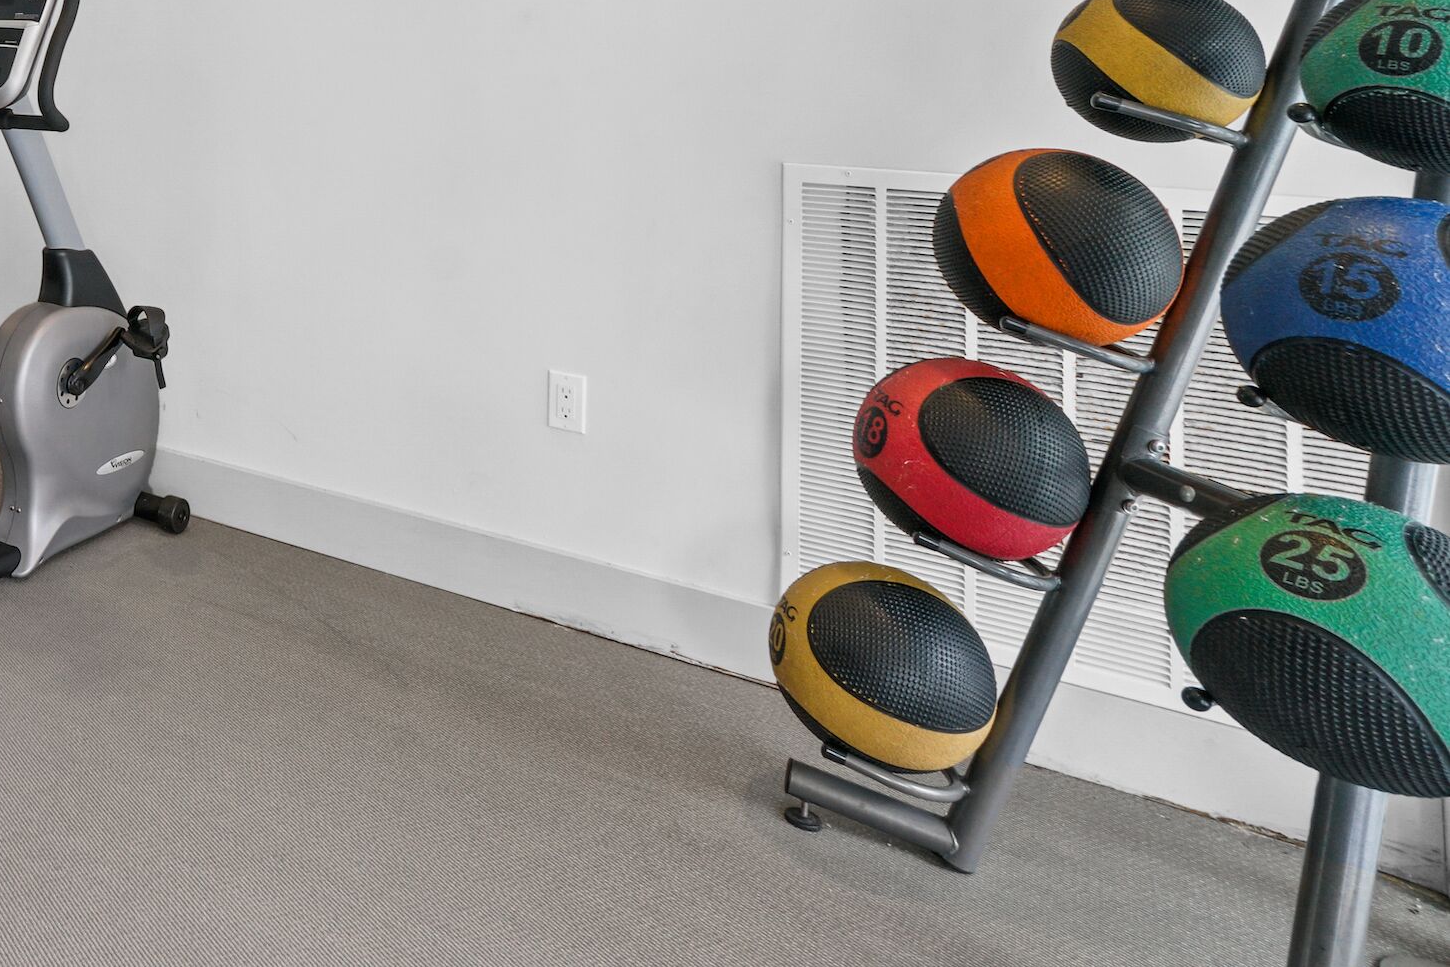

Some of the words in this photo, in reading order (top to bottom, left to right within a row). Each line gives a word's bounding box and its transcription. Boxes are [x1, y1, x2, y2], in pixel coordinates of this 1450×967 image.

[1371, 25, 1432, 59] 10
[1377, 59, 1410, 71] LBS
[1312, 260, 1382, 299] 15
[1269, 534, 1355, 581] 25
[1282, 571, 1324, 594] LBS
